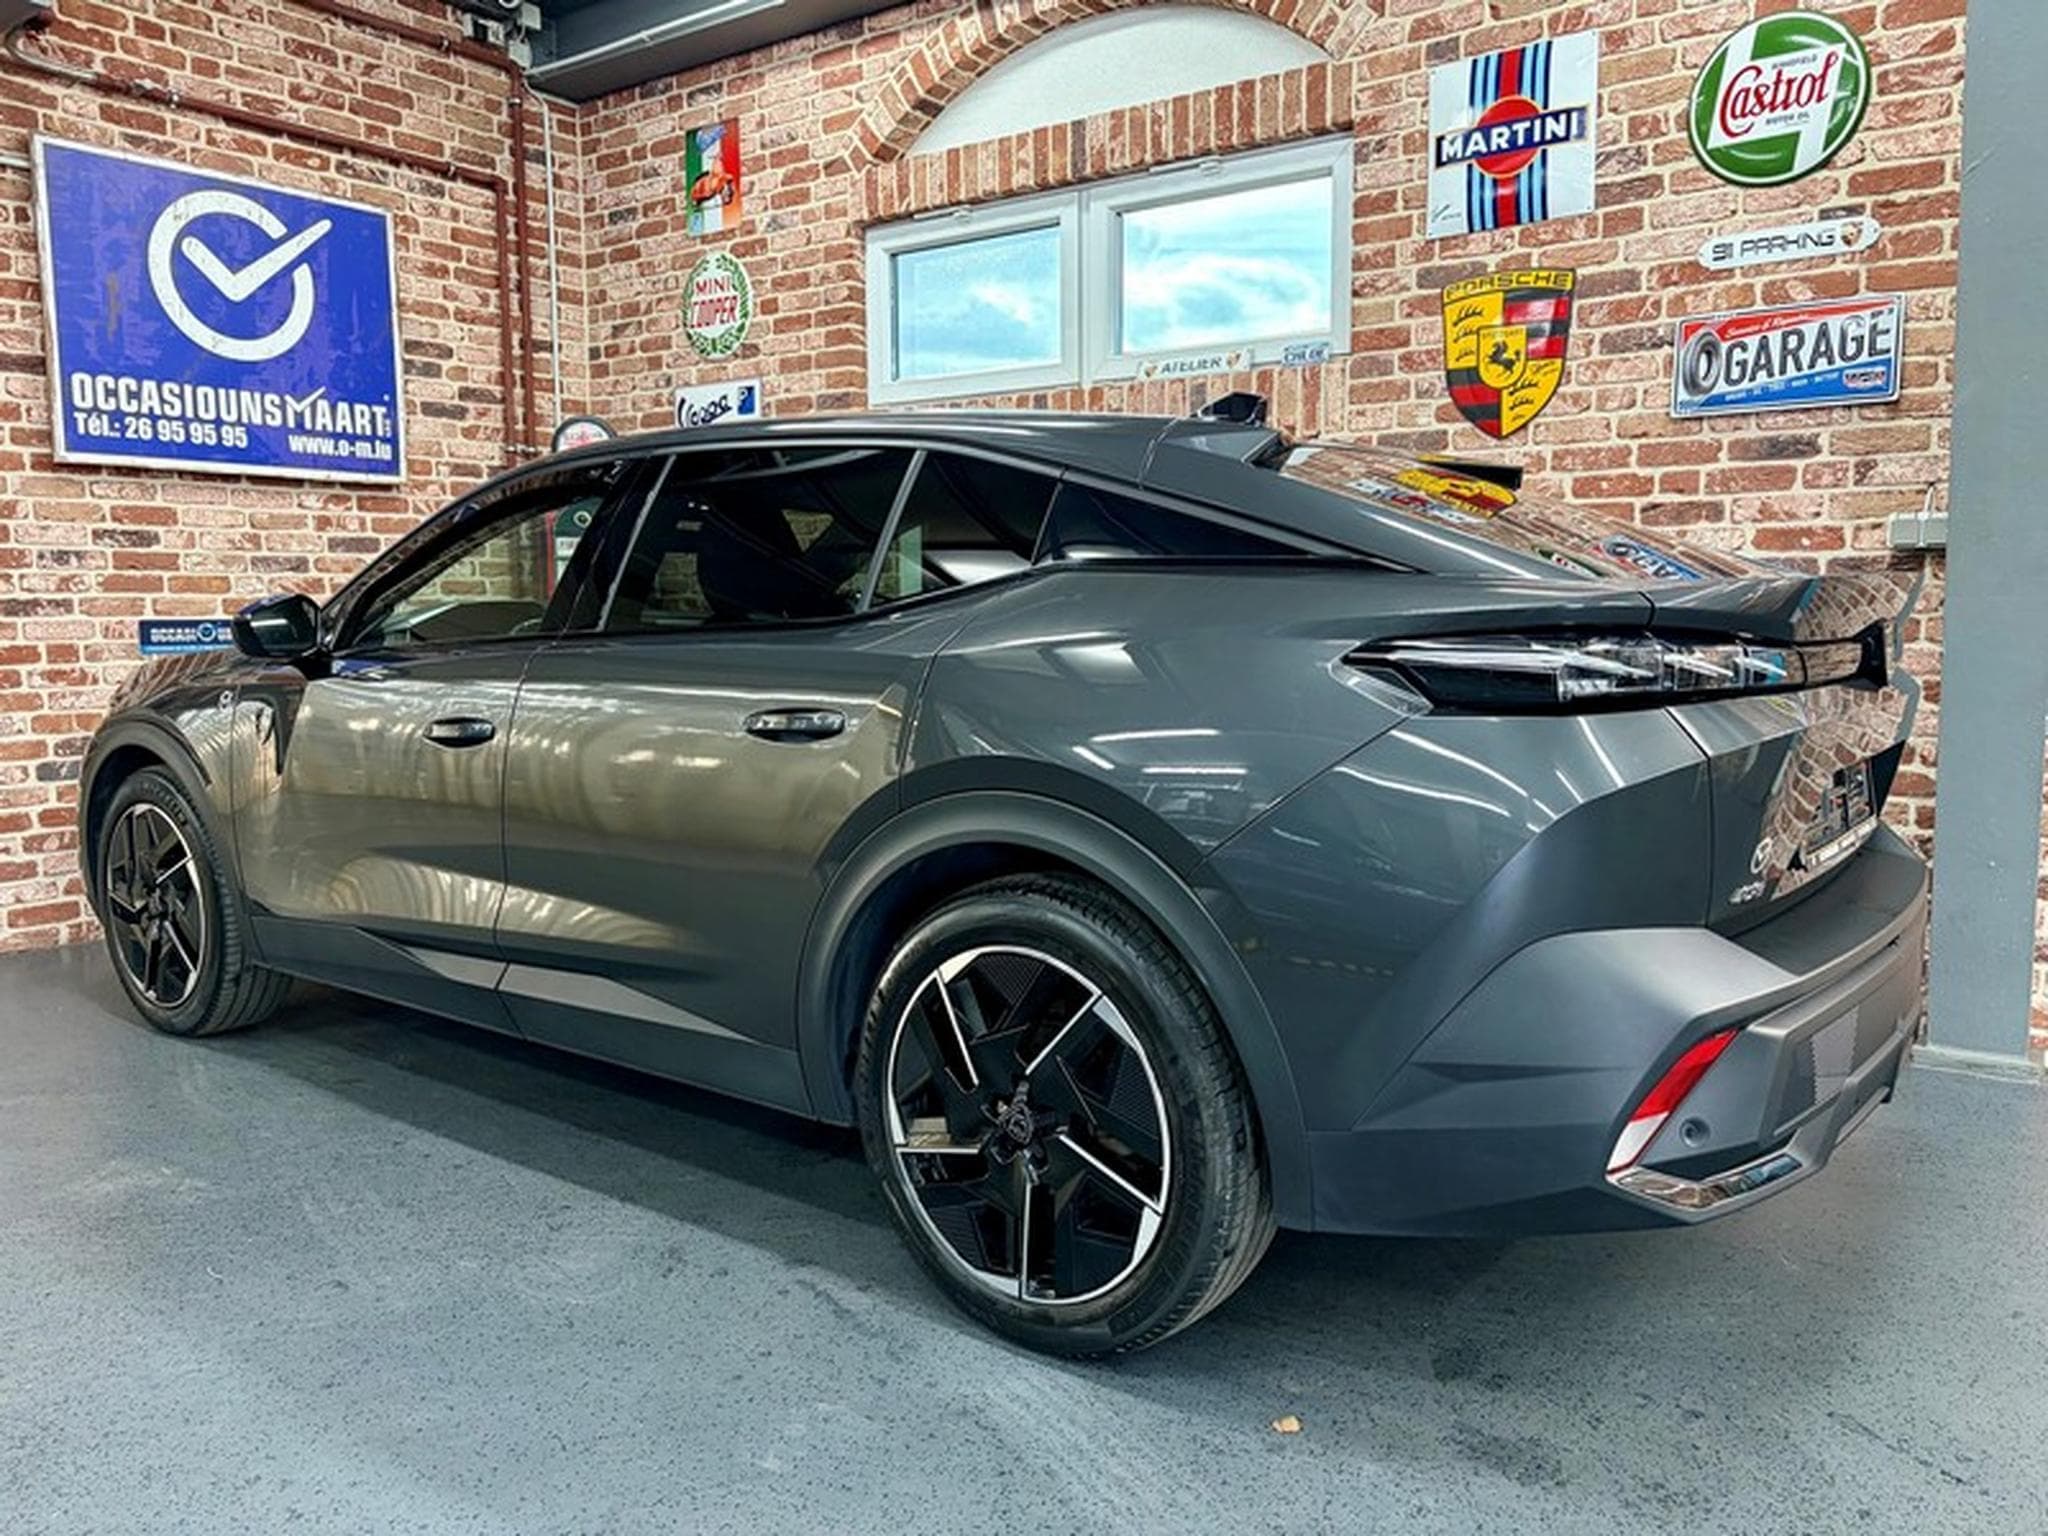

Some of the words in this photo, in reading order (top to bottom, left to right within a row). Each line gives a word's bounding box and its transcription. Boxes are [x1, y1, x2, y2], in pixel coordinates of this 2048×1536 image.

[1719, 50, 1839, 139] Castrol
[1441, 110, 1579, 163] MARTINI
[1741, 228, 1836, 257] PARKING
[695, 275, 731, 296] MINI
[1446, 271, 1570, 299] PORSCHE
[1723, 312, 1892, 387] GARAGE
[124, 416, 153, 442] 26
[156, 418, 186, 444] 95
[189, 421, 218, 446] 95
[221, 424, 249, 449] 95
[287, 433, 393, 461] www.o-m.lu
